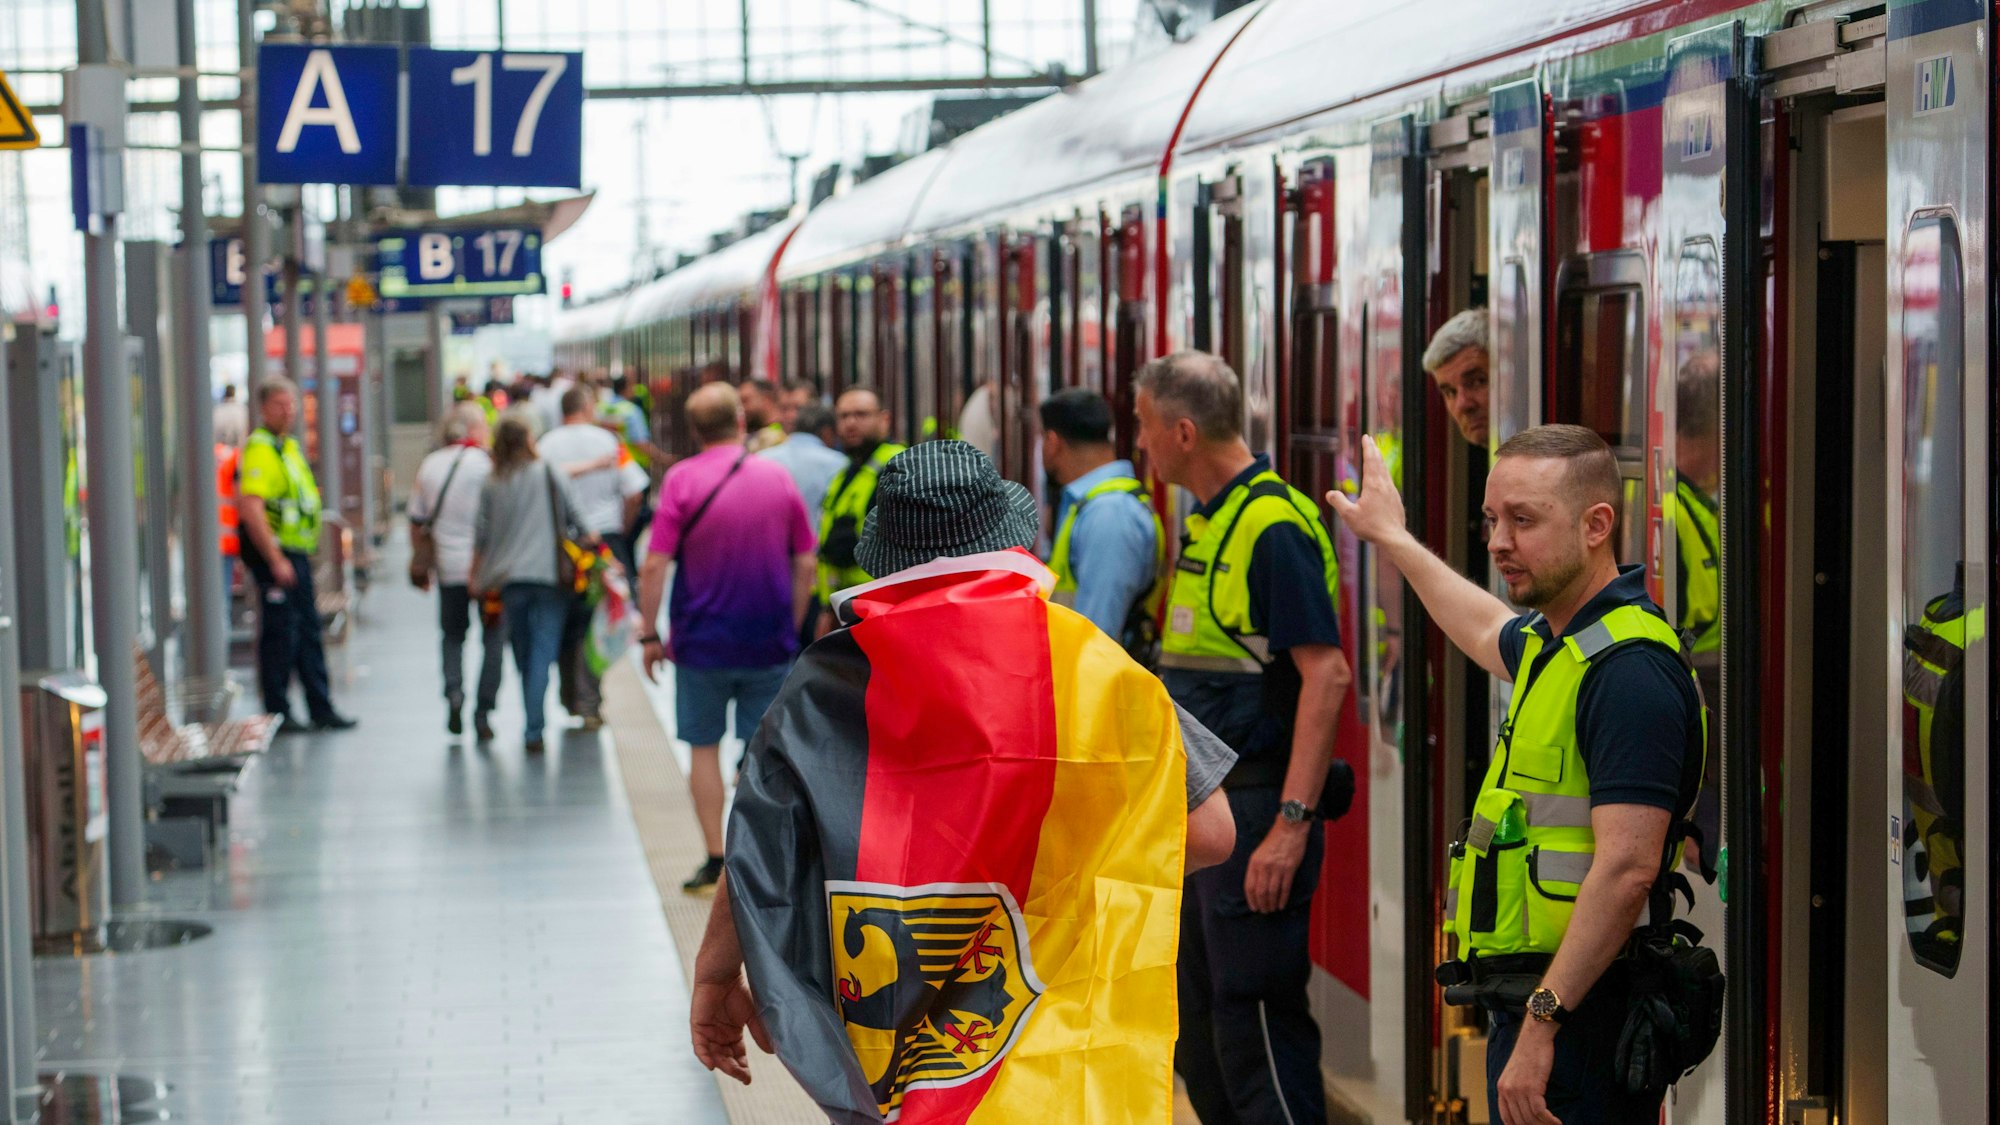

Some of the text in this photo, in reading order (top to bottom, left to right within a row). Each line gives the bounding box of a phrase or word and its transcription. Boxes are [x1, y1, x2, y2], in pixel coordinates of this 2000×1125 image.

[276, 50, 567, 158] A 17
[418, 229, 523, 280] B 17
